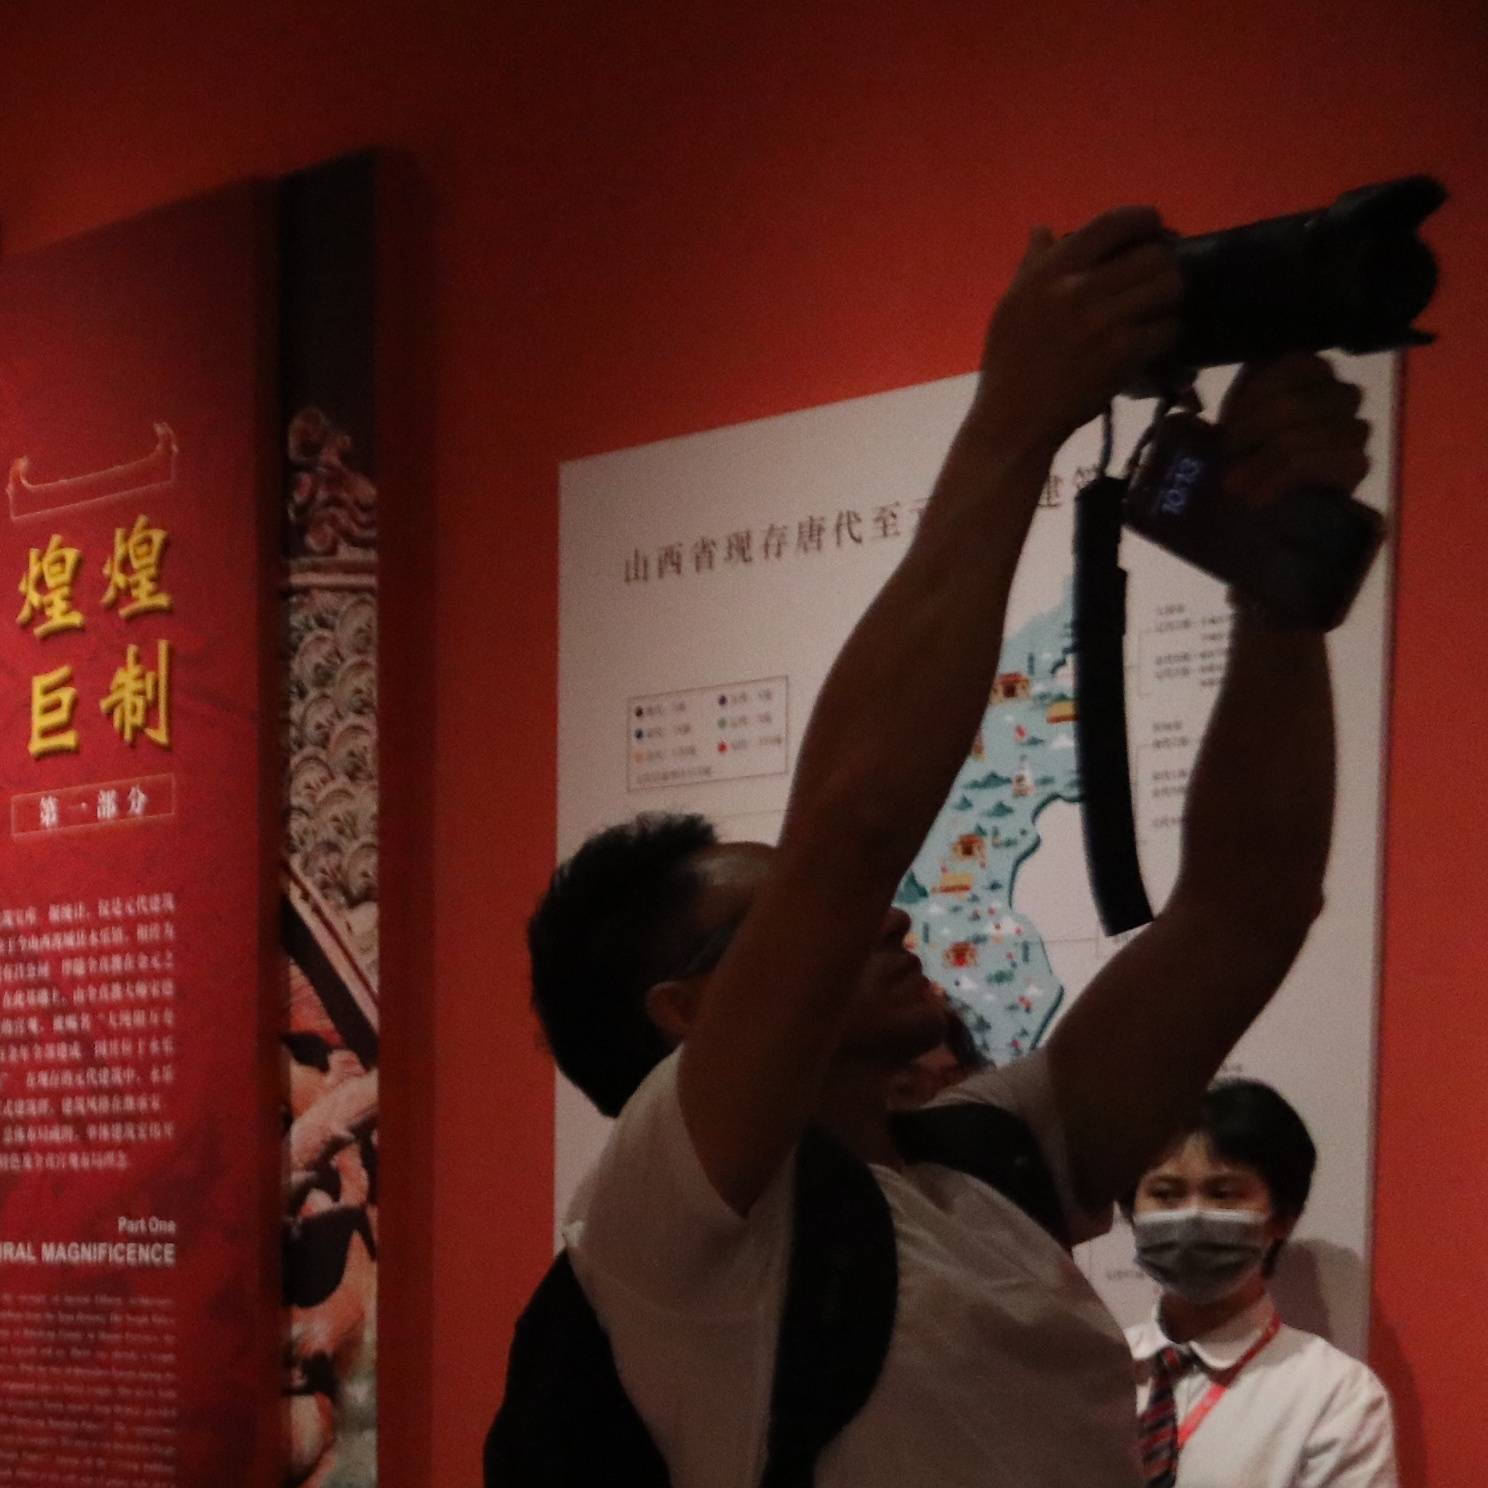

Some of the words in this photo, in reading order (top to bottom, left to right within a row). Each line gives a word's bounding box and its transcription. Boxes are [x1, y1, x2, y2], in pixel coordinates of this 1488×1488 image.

[15, 514, 174, 640] 煌煌
[27, 639, 173, 759] 巨制
[38, 784, 151, 828] 第一部分
[117, 1215, 146, 1233] Part
[148, 1217, 176, 1234] One
[41, 1241, 176, 1267] MAGNIFICENCE
